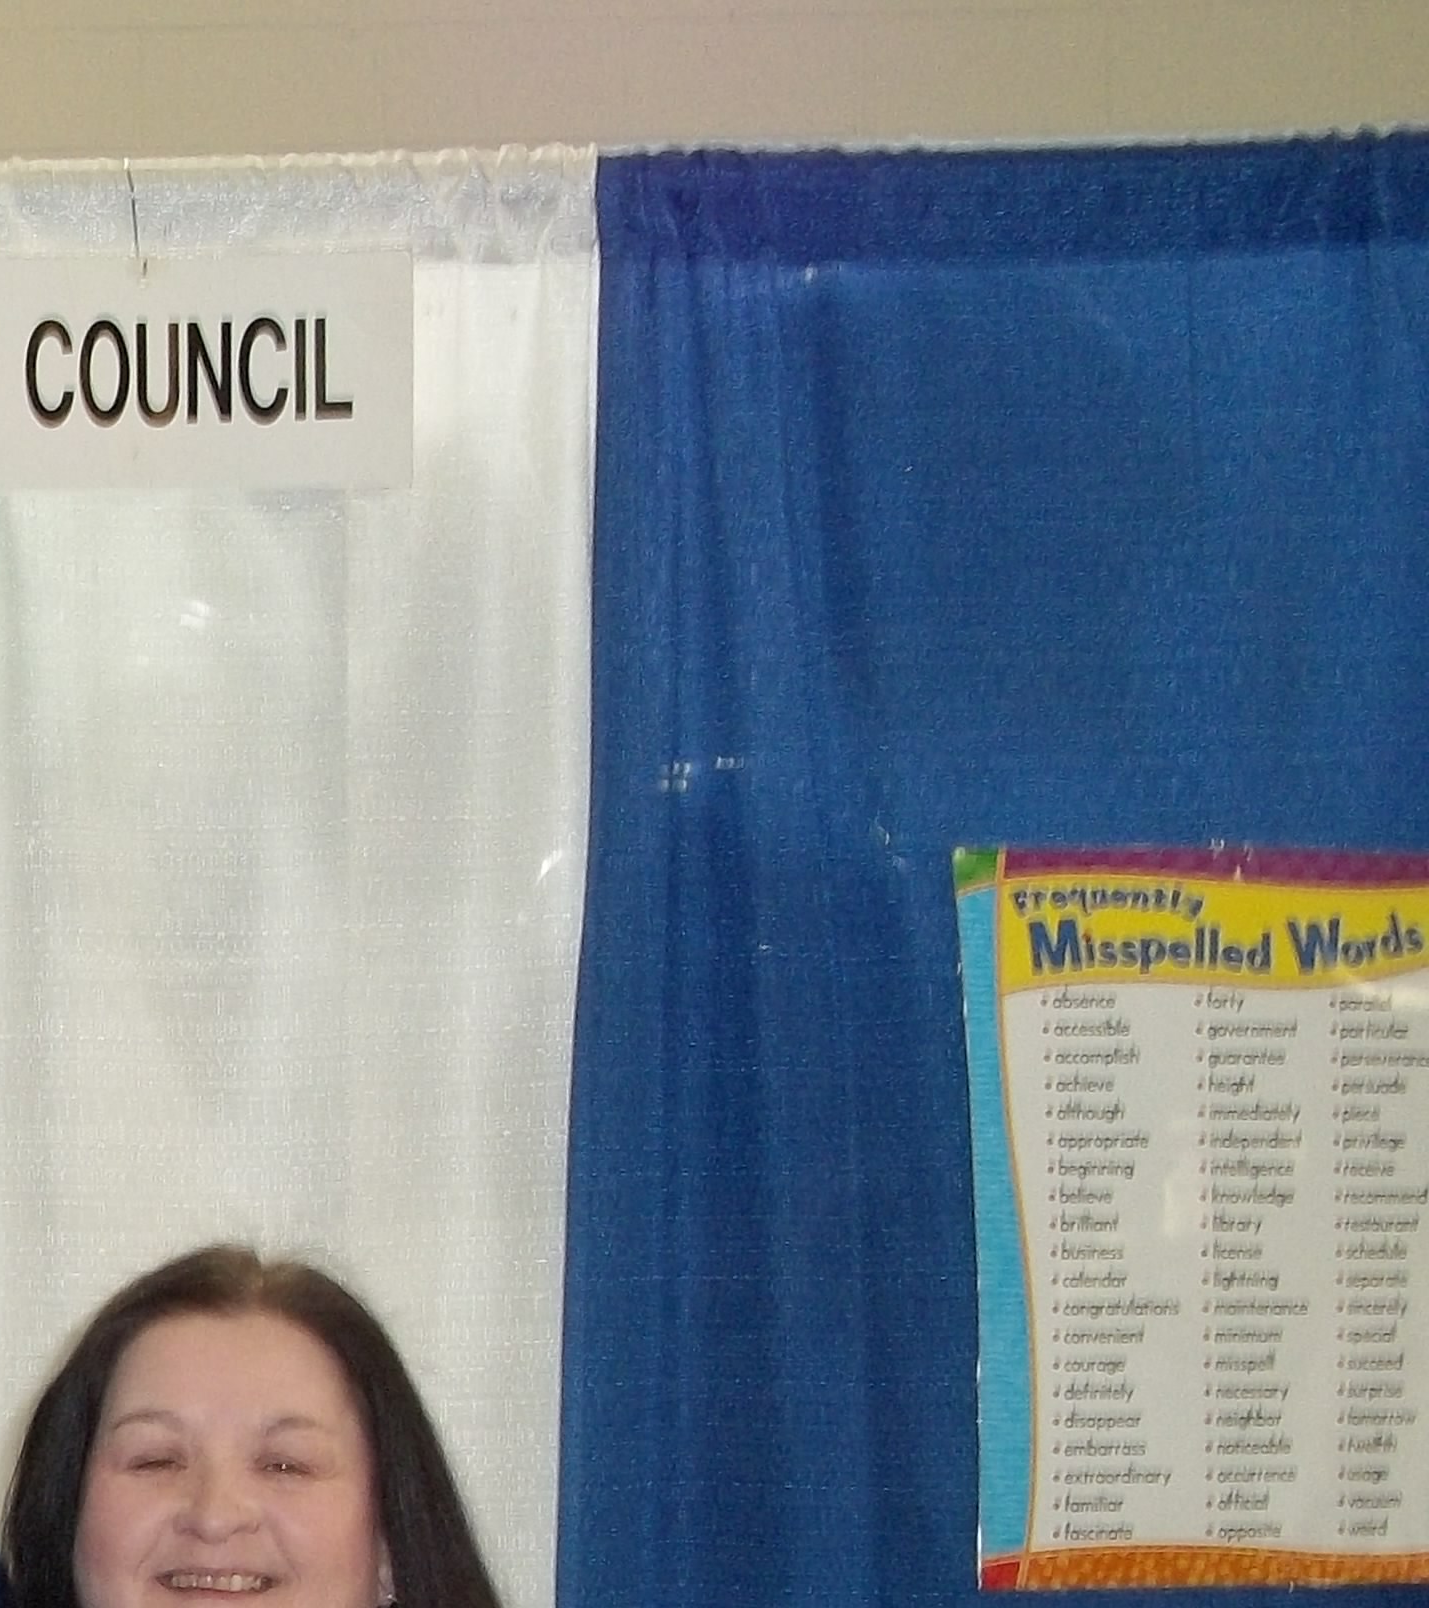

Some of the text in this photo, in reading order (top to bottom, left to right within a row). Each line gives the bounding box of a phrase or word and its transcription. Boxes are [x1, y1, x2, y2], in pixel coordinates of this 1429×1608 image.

[25, 315, 353, 430] COUNCIL
[1012, 885, 1204, 921] Frequently
[1029, 912, 1424, 975] Misspelled Words
[1054, 1019, 1130, 1037] accessible
[1208, 1020, 1297, 1039] government
[1061, 1241, 1124, 1260] business
[1065, 1410, 1141, 1430] disappear
[1065, 1439, 1145, 1457] embarrass
[1065, 1465, 1171, 1487] extraordinary
